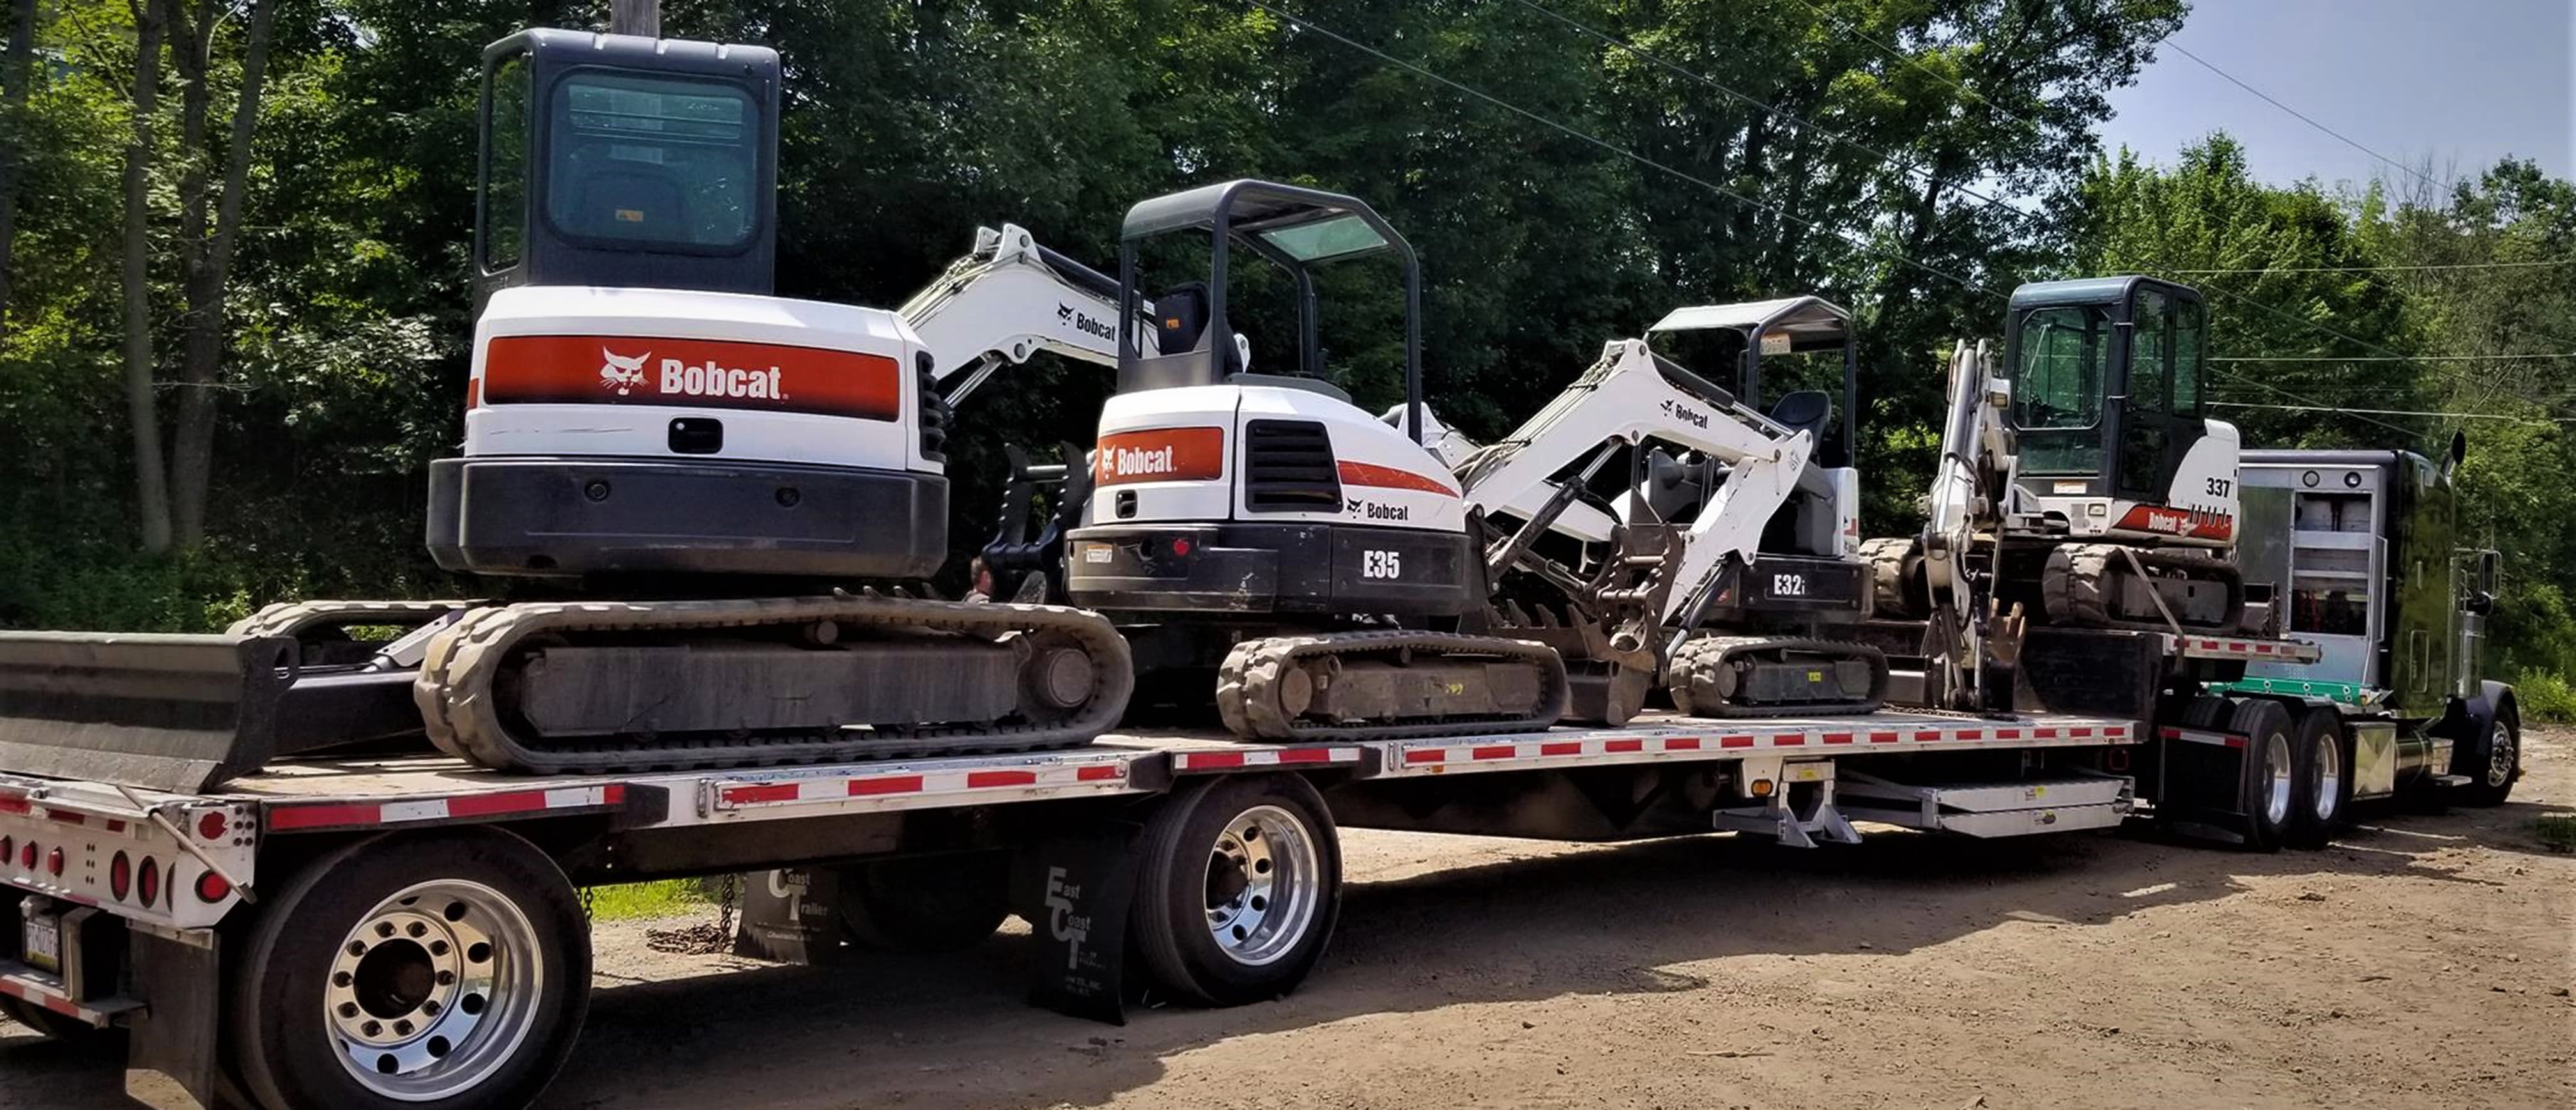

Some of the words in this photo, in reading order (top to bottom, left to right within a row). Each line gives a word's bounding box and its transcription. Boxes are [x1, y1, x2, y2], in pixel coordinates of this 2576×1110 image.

[1076, 312, 1116, 342] Bobcat
[660, 358, 781, 400] Bobcat
[1675, 403, 1708, 429] Bobcat
[1117, 445, 1173, 475] Bobcat
[2206, 477, 2230, 498] 337
[1367, 502, 1409, 521] Bobcat
[2147, 511, 2177, 532] Bobcat
[1363, 550, 1400, 578] E35
[1774, 574, 1805, 596] E32i
[1045, 866, 1081, 907] East
[1050, 895, 1091, 943] Coast
